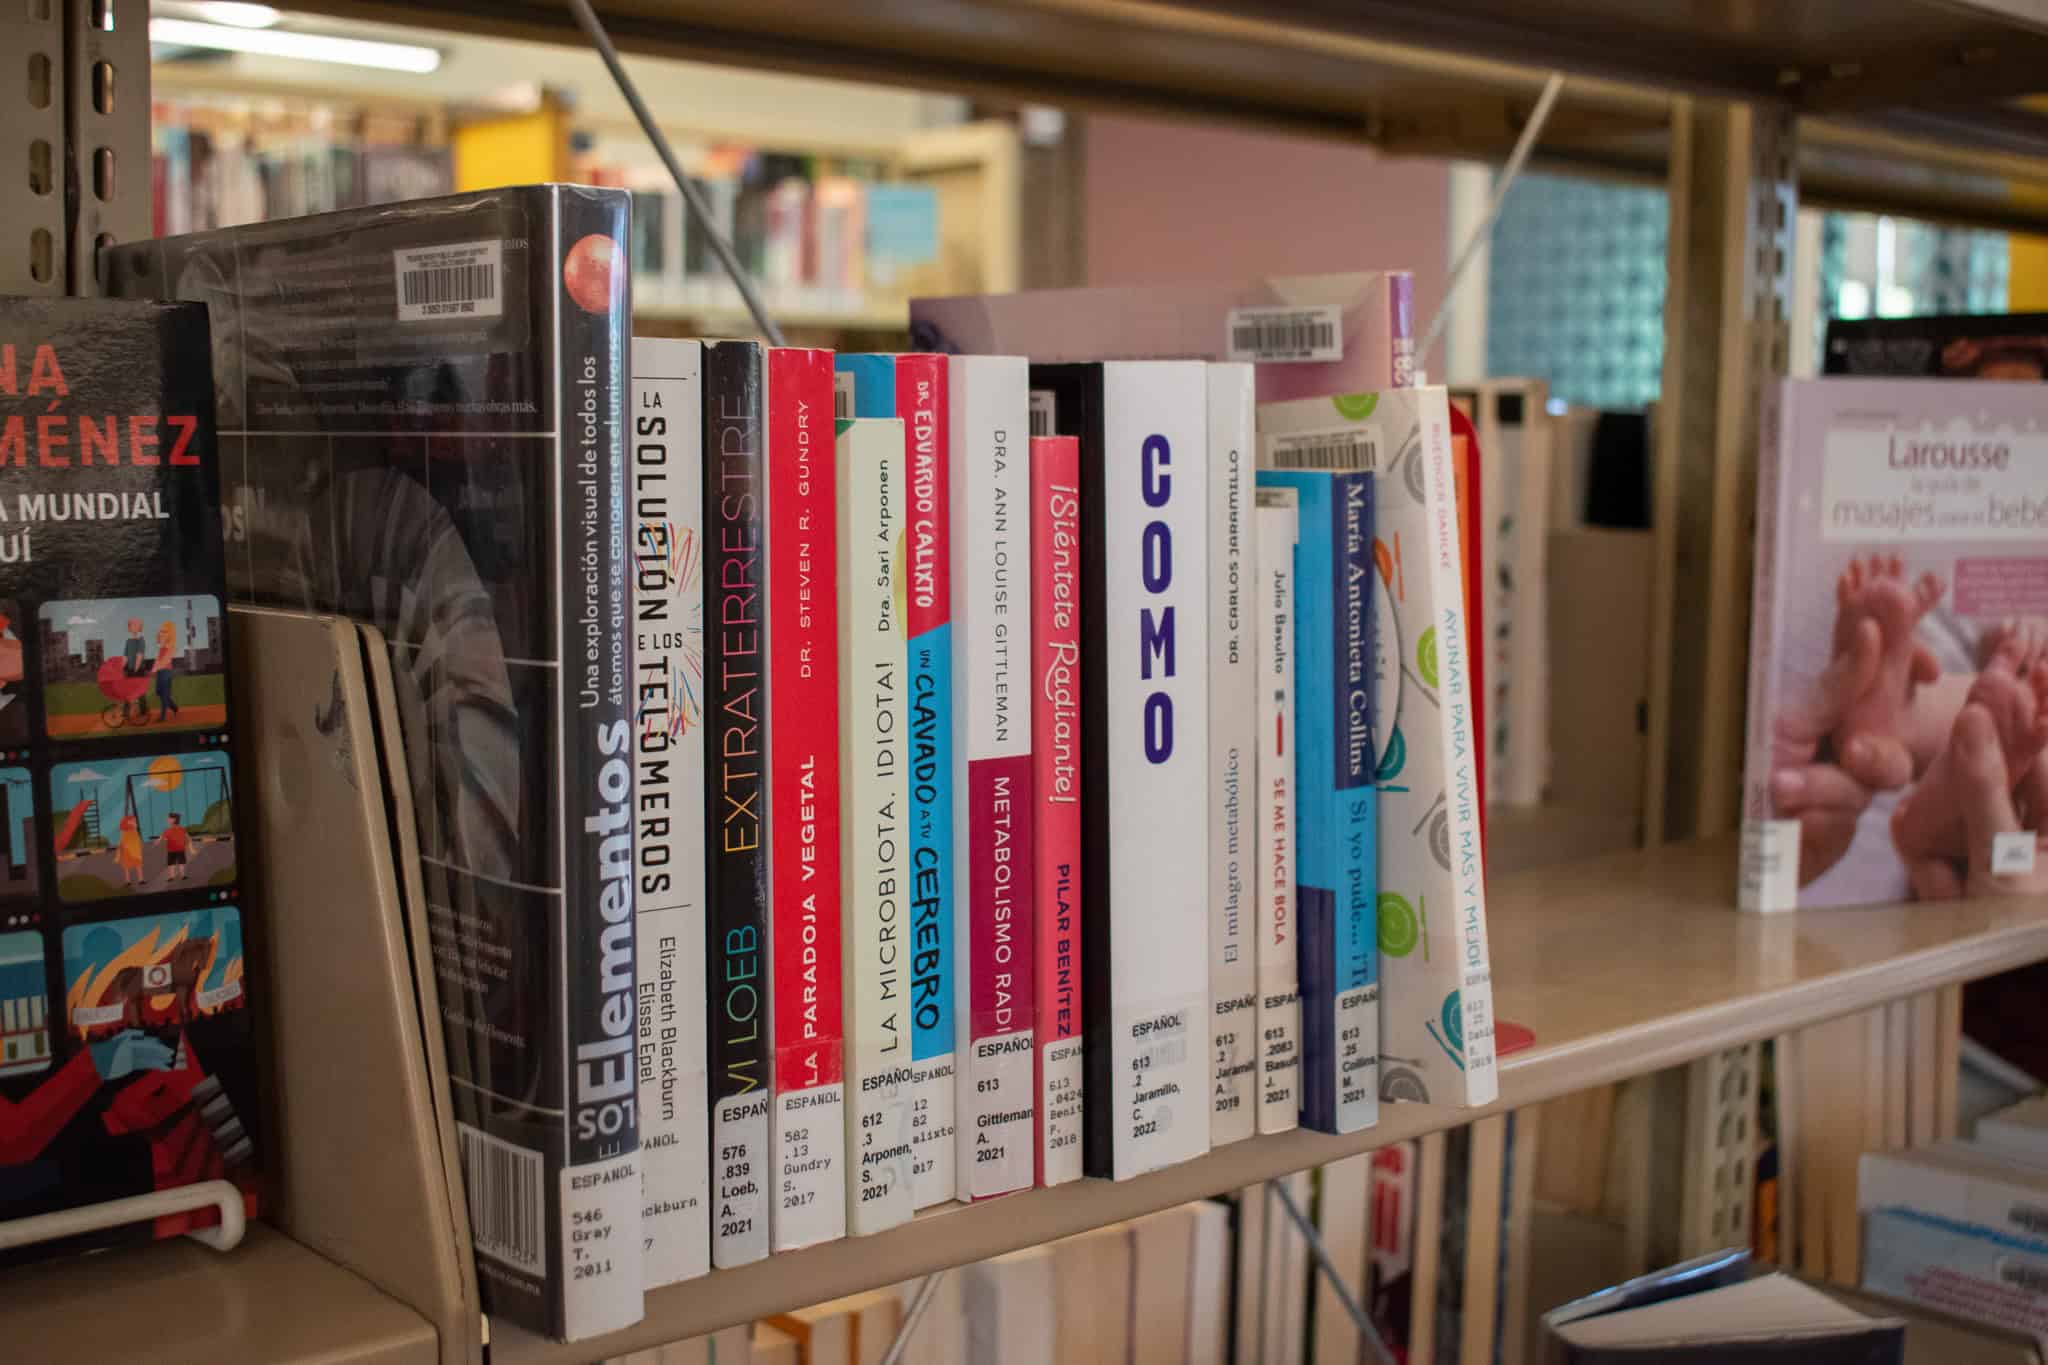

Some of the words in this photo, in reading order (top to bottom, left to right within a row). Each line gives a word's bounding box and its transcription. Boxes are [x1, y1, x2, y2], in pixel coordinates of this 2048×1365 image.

[575, 355, 597, 384] los
[576, 388, 598, 445] todos
[642, 391, 663, 409] LA
[577, 450, 598, 476] de
[797, 400, 811, 496] GUNDRY
[993, 429, 1007, 479] DRA.
[1887, 434, 2011, 473] Larousse
[18, 492, 170, 521] MUNDIAL
[577, 480, 598, 538] visual
[608, 473, 624, 563] conocen
[636, 416, 676, 621] SOLUCIÓN
[799, 508, 811, 530] R.
[877, 459, 893, 542] Arponen
[994, 487, 1008, 532] ANN
[1228, 449, 1241, 557] JARAMILLO
[1346, 482, 1366, 554] María
[877, 549, 890, 588] Sari
[913, 519, 935, 608] CALIXTO
[1048, 484, 1079, 630] ¡Siéntete
[609, 570, 624, 590] se
[799, 543, 812, 628] STEVEN
[994, 541, 1008, 616] LOUISE
[1228, 560, 1240, 630] CARLOS
[1273, 569, 1287, 609] Julio
[578, 538, 602, 662] exploración
[608, 590, 625, 629] que
[877, 594, 891, 632] Dra.
[1139, 433, 1177, 766] COMO
[653, 632, 684, 649] LOS
[720, 394, 760, 852] EXTRATERRESTRE
[1348, 562, 1367, 683] Antonieta
[608, 630, 624, 706] átomos
[799, 640, 812, 679] DR.
[919, 649, 931, 669] UN
[1229, 635, 1240, 664] DR.
[1443, 608, 1463, 695] AYUNAR
[579, 662, 601, 709] Una
[994, 623, 1009, 743] GITTLEMAN
[875, 662, 895, 778] IDIOTA!
[911, 673, 937, 806] CLAVADO
[1044, 639, 1080, 804] Radiante!
[1349, 689, 1369, 777] Collins
[1450, 703, 1466, 759] PARA
[639, 655, 677, 895] TELÓMEROS
[1273, 776, 1286, 801] SE
[1455, 765, 1472, 823] VIVIR
[800, 754, 816, 882] VEGETAL
[1224, 747, 1239, 855] metabólico
[1273, 805, 1286, 833] ME
[1350, 799, 1368, 823] Si
[1273, 837, 1287, 889] HACE
[1347, 831, 1363, 860] yo
[993, 776, 1013, 964] METABOLISMO
[877, 791, 898, 1000] MICROBIOTA.
[1056, 863, 1071, 932] PILAR
[1224, 860, 1242, 937] milagro
[1463, 885, 1477, 898] Y
[577, 719, 635, 1105] Elementos
[1273, 895, 1287, 946] BOLA
[911, 846, 940, 1031] CEREBRO
[1224, 943, 1239, 964] El
[659, 936, 679, 1022] Elizabeth
[725, 924, 758, 1046] LOEB
[801, 893, 818, 1040] PARADOJA
[995, 973, 1014, 1033] RADI
[1057, 939, 1074, 1037] BENÍTEZ
[639, 982, 656, 1038] Elissa
[1132, 1013, 1182, 1038] ESPAÑOL
[880, 1012, 898, 1053] LA
[1215, 1033, 1235, 1047] 613
[1265, 1027, 1285, 1041] 613
[1342, 1027, 1360, 1041] 613
[639, 1043, 657, 1084] Epel
[661, 1026, 680, 1120] Blackburn
[804, 1051, 819, 1086] LA
[1132, 1055, 1151, 1072] 613
[977, 1078, 1000, 1093] 613
[1050, 1077, 1070, 1092] 613
[1132, 1082, 1180, 1105] Jaramillo,
[1265, 1088, 1291, 1104] 2021
[862, 1111, 883, 1128] 612
[1132, 1108, 1143, 1121] C.
[1132, 1120, 1157, 1139] 2022
[722, 1144, 746, 1160] 576
[784, 1128, 809, 1143] 582
[785, 1144, 809, 1159] .13
[861, 1132, 873, 1147] .3
[861, 1143, 912, 1166] Arponen,
[912, 1126, 954, 1145] alixto
[976, 1132, 990, 1146] A.
[976, 1146, 1005, 1163] 2021
[721, 1162, 750, 1181] .839
[783, 1158, 831, 1176] Gundry
[783, 1181, 796, 1192] S.
[861, 1169, 873, 1183] S.
[721, 1181, 759, 1199] Loeb,
[783, 1191, 815, 1209] 2017
[861, 1183, 888, 1202] 2021
[572, 1208, 603, 1225] 546
[720, 1204, 736, 1219] A.
[720, 1218, 752, 1238] 2021
[572, 1224, 612, 1243] Gray
[573, 1248, 590, 1261] T.
[573, 1259, 612, 1280] 2011
